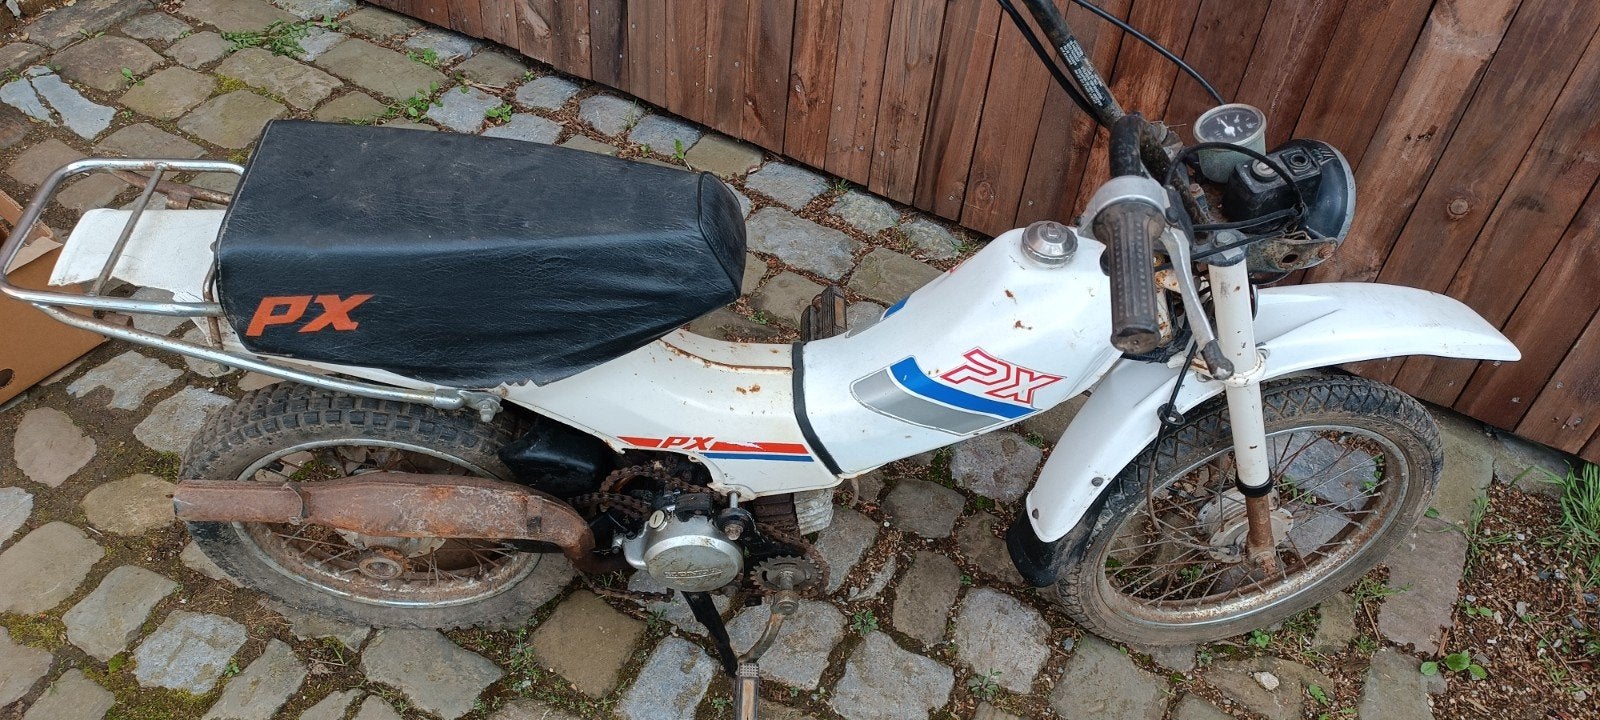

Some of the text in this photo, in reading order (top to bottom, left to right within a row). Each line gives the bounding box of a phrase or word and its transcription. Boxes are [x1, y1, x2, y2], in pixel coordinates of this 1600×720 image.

[246, 293, 375, 337] PX
[940, 348, 1064, 404] PX
[660, 436, 715, 451] PX
